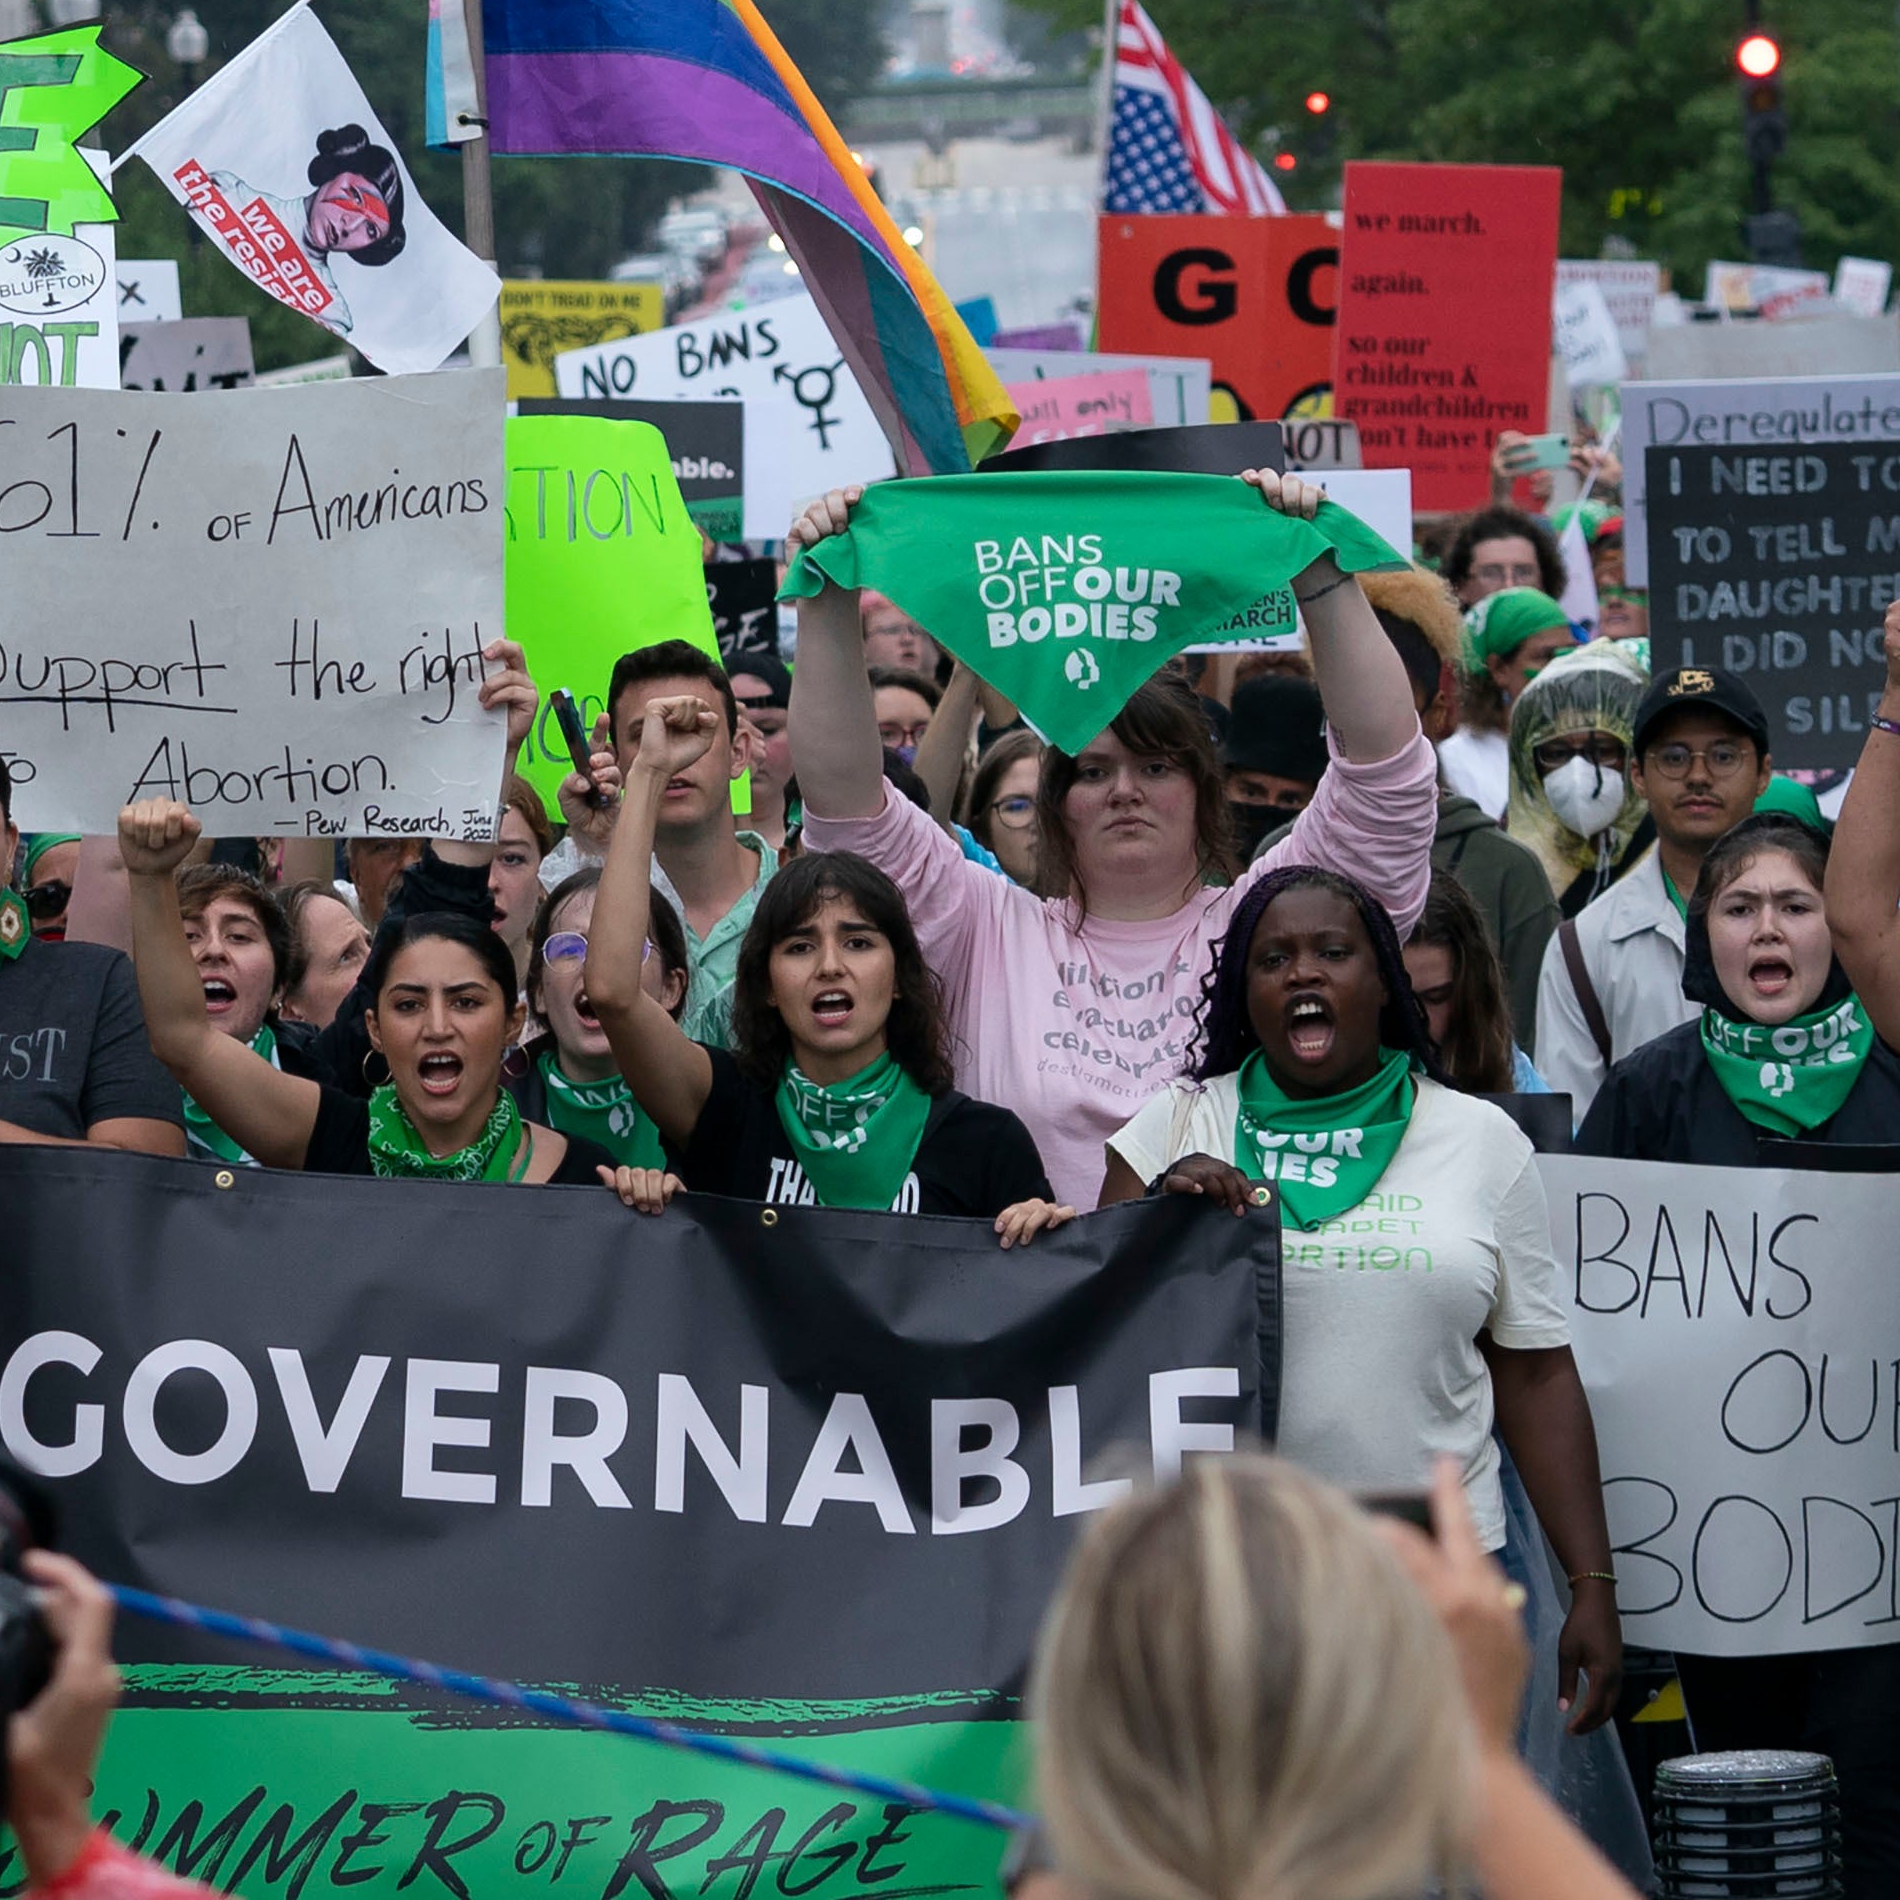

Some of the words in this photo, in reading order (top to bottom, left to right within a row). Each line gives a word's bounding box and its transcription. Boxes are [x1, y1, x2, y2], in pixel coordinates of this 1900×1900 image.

[181, 167, 228, 223] the
[241, 204, 287, 252] we
[1355, 213, 1390, 232] we
[1399, 210, 1486, 235] march.
[223, 224, 300, 309] resist
[278, 255, 326, 312] are
[1350, 272, 1430, 299] again.
[503, 290, 545, 309] DON'T
[551, 291, 593, 309] TREAD
[582, 354, 636, 398] NO
[677, 319, 780, 380] BANS
[1348, 335, 1377, 355] so
[1384, 337, 1431, 357] our
[1346, 361, 1454, 388] children
[1344, 392, 1530, 421] grandchildren
[1358, 423, 1407, 447] on't
[1415, 424, 1478, 450] have
[267, 433, 489, 545] Americans
[1668, 456, 1682, 496] I
[1710, 455, 1828, 496] NEED
[507, 466, 667, 542] TION
[974, 534, 1102, 575] BANS
[1672, 526, 1732, 564] TO
[1748, 517, 1847, 563] TELL
[979, 565, 1068, 611] OFF
[1073, 566, 1182, 608] OUR
[986, 601, 1160, 649] BODIES
[275, 617, 377, 701] the
[399, 620, 487, 724] right
[1722, 631, 1808, 673] DID
[127, 735, 396, 806] Abortion.
[305, 809, 347, 836] Pew
[363, 804, 457, 836] Research,
[1771, 1001, 1863, 1057] OUR
[1575, 1192, 1819, 1320] BANS
[514, 1814, 612, 1883] OF
[598, 1796, 936, 1900] RAGE
